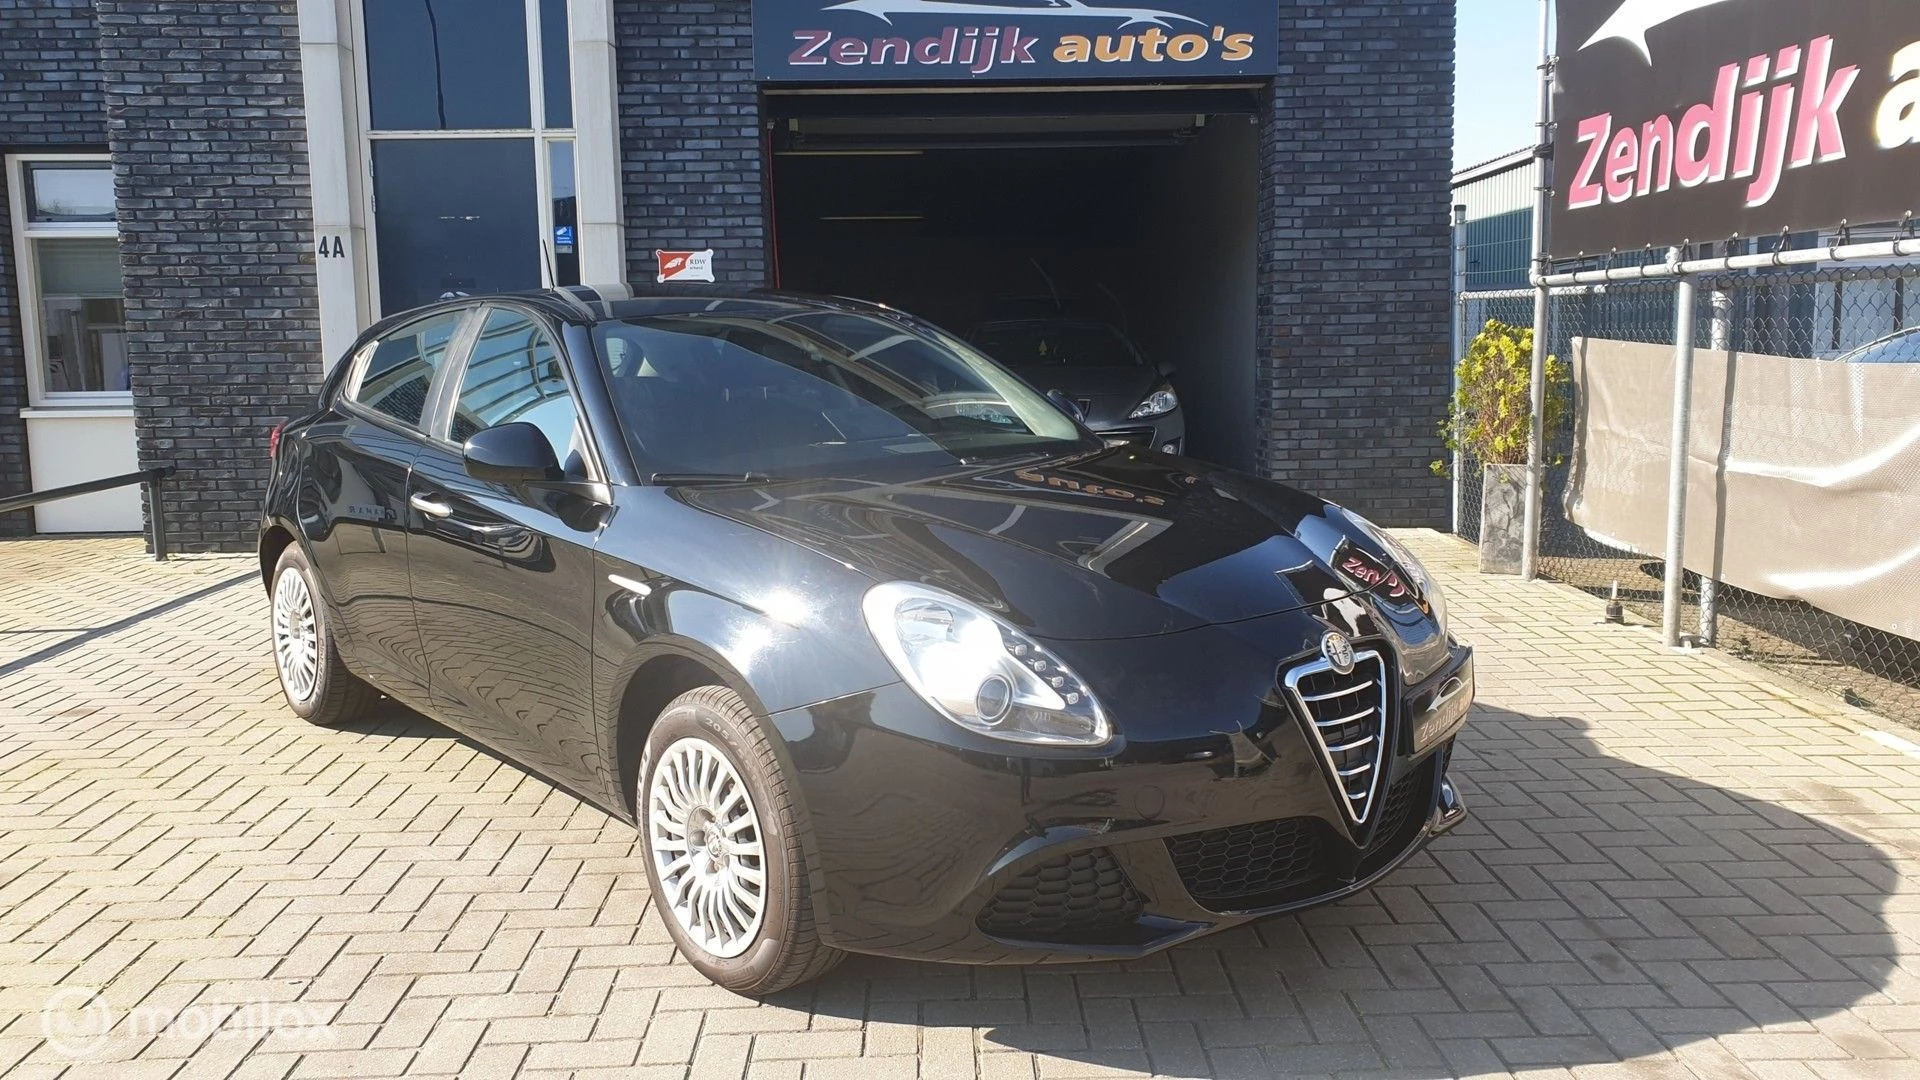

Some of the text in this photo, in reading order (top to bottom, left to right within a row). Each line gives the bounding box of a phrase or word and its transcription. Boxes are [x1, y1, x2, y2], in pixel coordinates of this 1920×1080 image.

[788, 25, 1254, 74] Zendijk auto's
[1567, 34, 1861, 210] Zendijk
[318, 235, 345, 258] 4A
